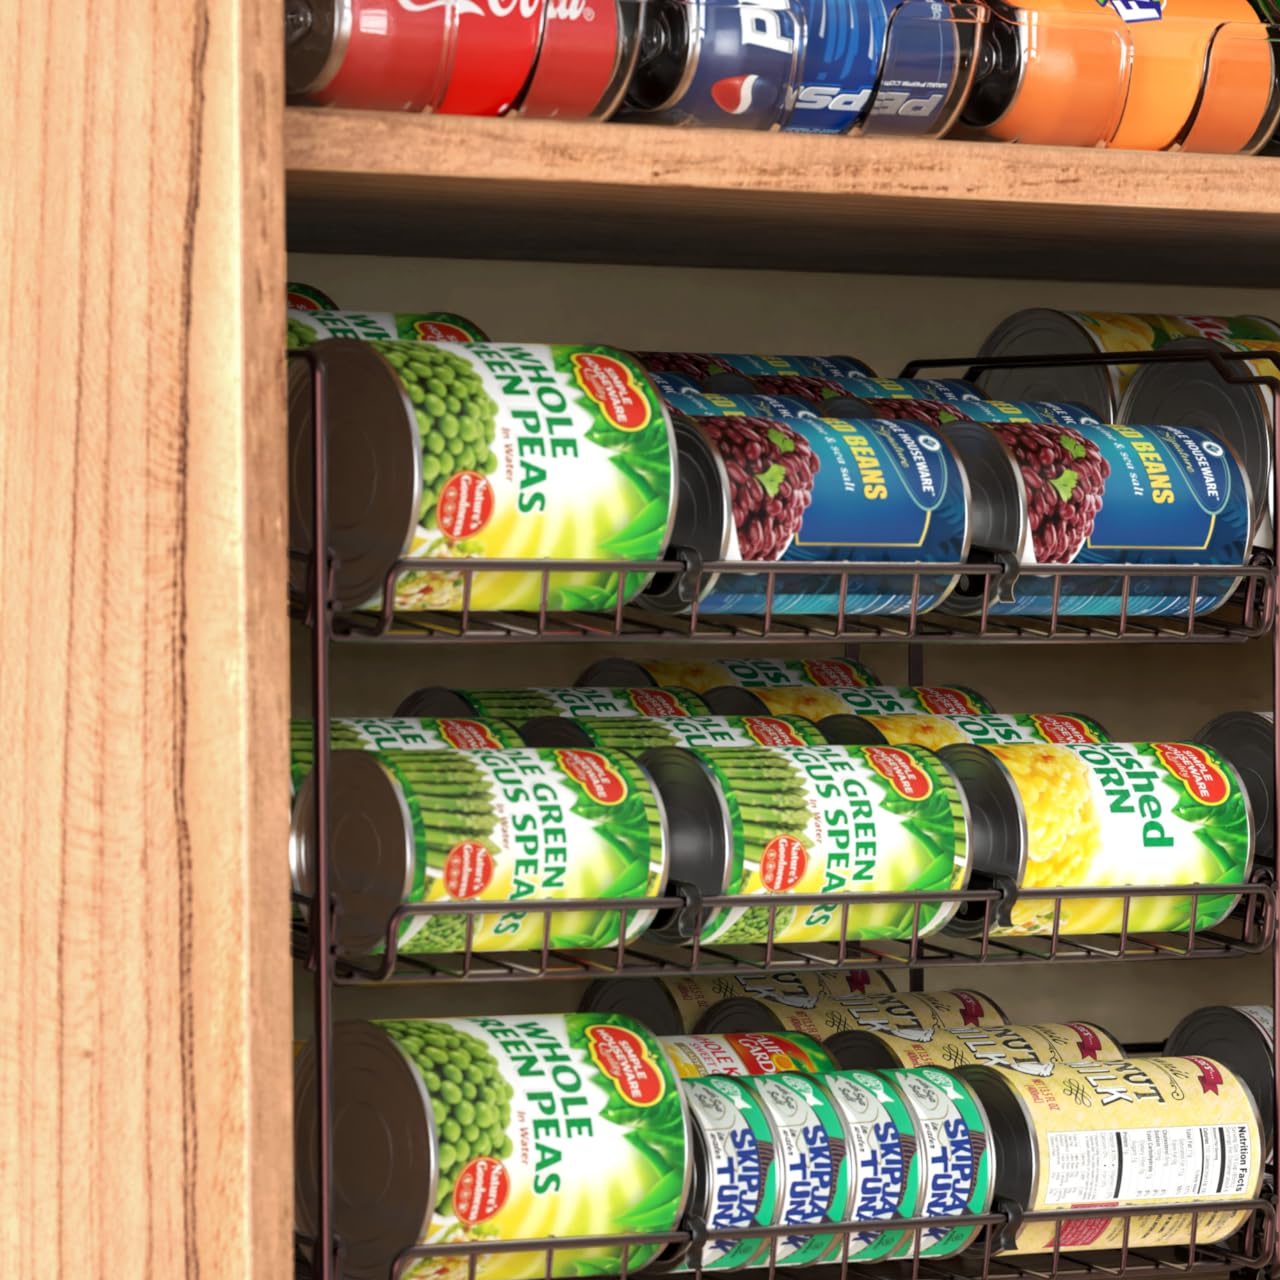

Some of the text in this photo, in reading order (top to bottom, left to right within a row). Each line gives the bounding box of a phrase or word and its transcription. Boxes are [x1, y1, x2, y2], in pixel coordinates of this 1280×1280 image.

[501, 346, 579, 459] WHOLE
[580, 355, 633, 424] SIMPLE HOUSEWARE
[504, 443, 514, 483] Water
[511, 409, 549, 514] PEAS
[830, 445, 855, 492] sea salt
[843, 435, 888, 501] BEANS
[900, 434, 934, 494] HOUSEWARE
[1120, 451, 1144, 497] sea salt
[1131, 440, 1175, 505] BEANS
[1184, 438, 1219, 498] HOUSEWARE
[584, 754, 610, 786] SIMPLE
[890, 751, 916, 781] SIMPLE
[1184, 749, 1213, 782] SIMPLE
[532, 782, 568, 889] GREEN
[813, 813, 823, 844] Water
[844, 779, 877, 881] GREEN
[786, 842, 801, 885] Nature's
[514, 1020, 593, 1139] WHOLE
[595, 1028, 643, 1099] HOUSEWARE
[617, 1039, 647, 1081] SIMPLE
[519, 1127, 529, 1165] Water
[526, 1092, 562, 1196] PEAS
[1235, 1126, 1249, 1192] Nutrition Facts
[484, 1163, 502, 1213] Nature's
